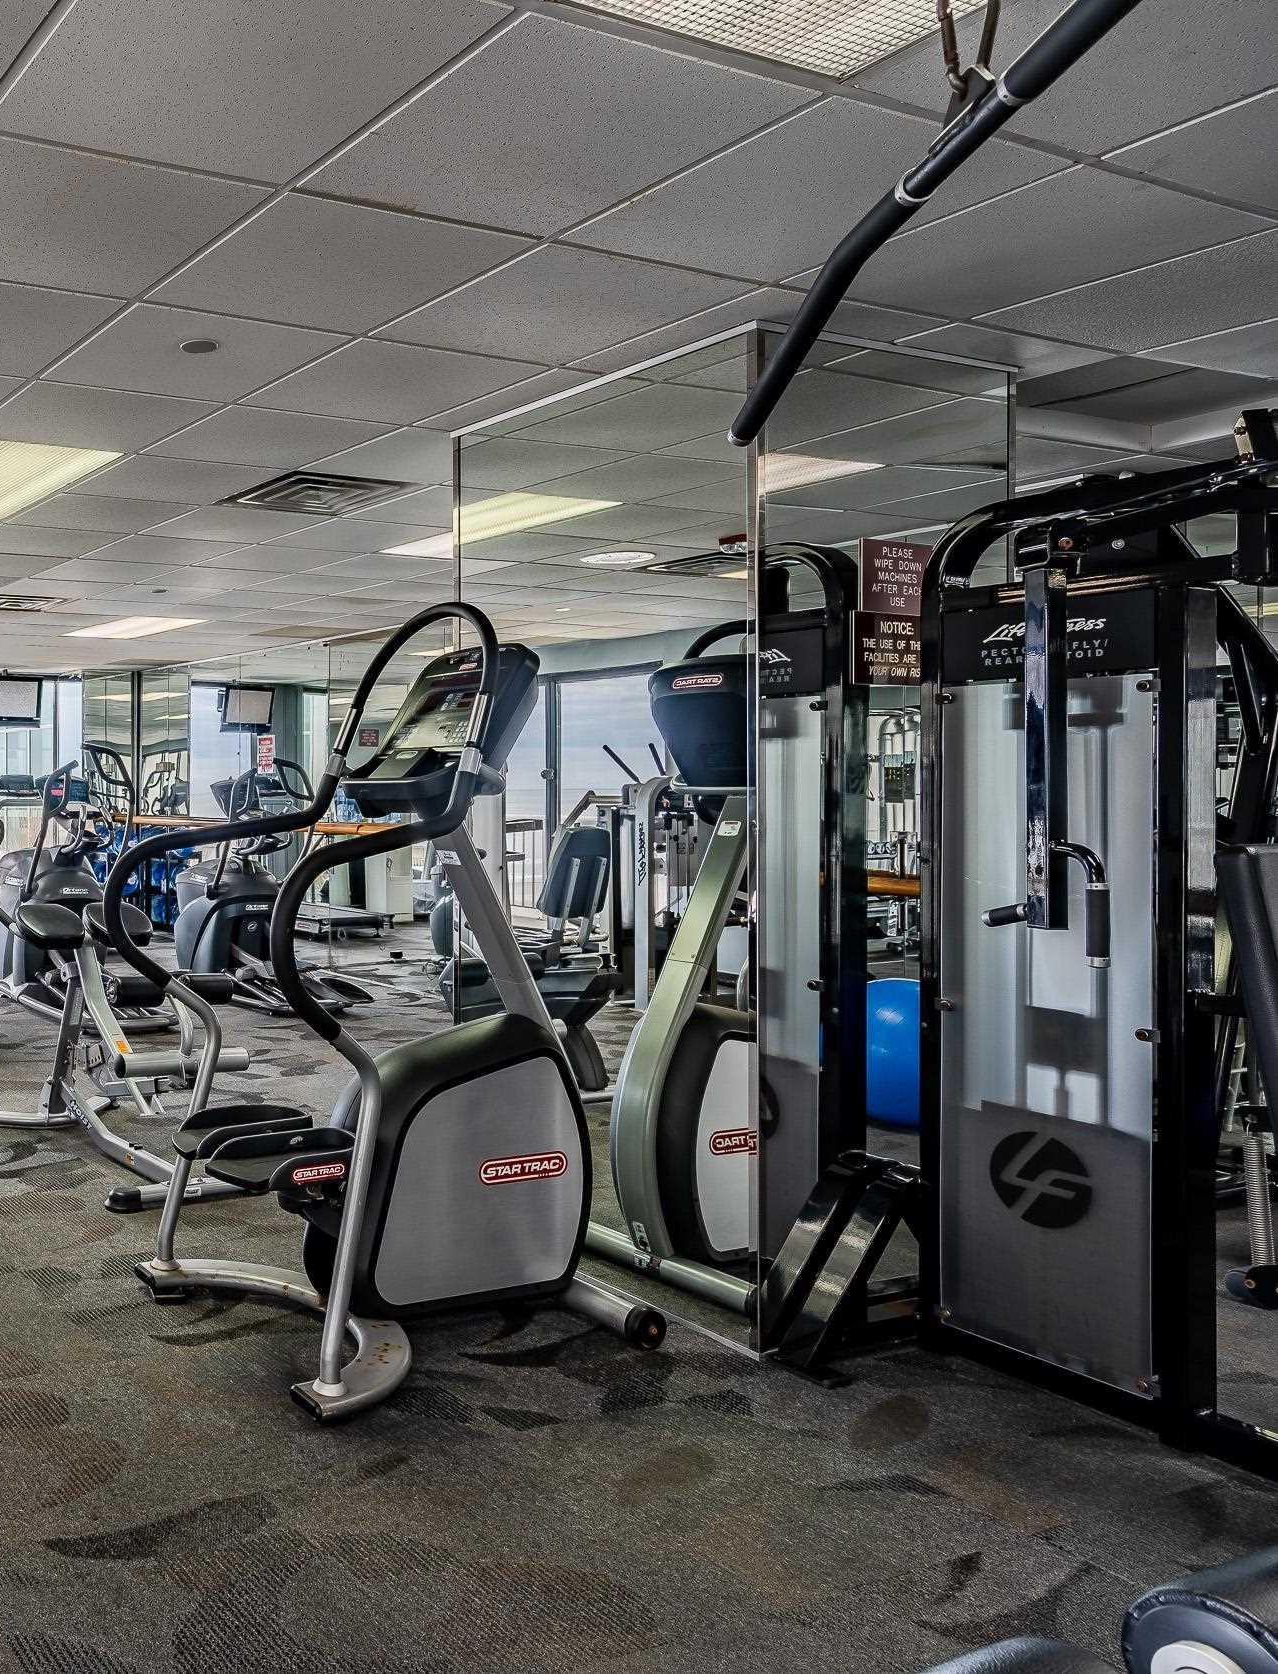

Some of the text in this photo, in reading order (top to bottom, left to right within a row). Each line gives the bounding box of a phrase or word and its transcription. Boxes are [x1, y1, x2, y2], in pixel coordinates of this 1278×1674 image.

[882, 546, 913, 559] PLEASE
[874, 558, 922, 572] WIPE DOWN
[878, 571, 918, 584] MACHINES
[871, 583, 898, 594] AFTER
[889, 597, 906, 607] USE
[862, 638, 877, 649] THE
[879, 639, 894, 650] USE
[896, 640, 906, 650] OF
[864, 652, 917, 664] FACILITIES ARE
[869, 665, 921, 678] YOUR OWN RIS
[296, 1166, 341, 1179] STAR TRAC
[486, 1158, 561, 1178] STAR TRAC
